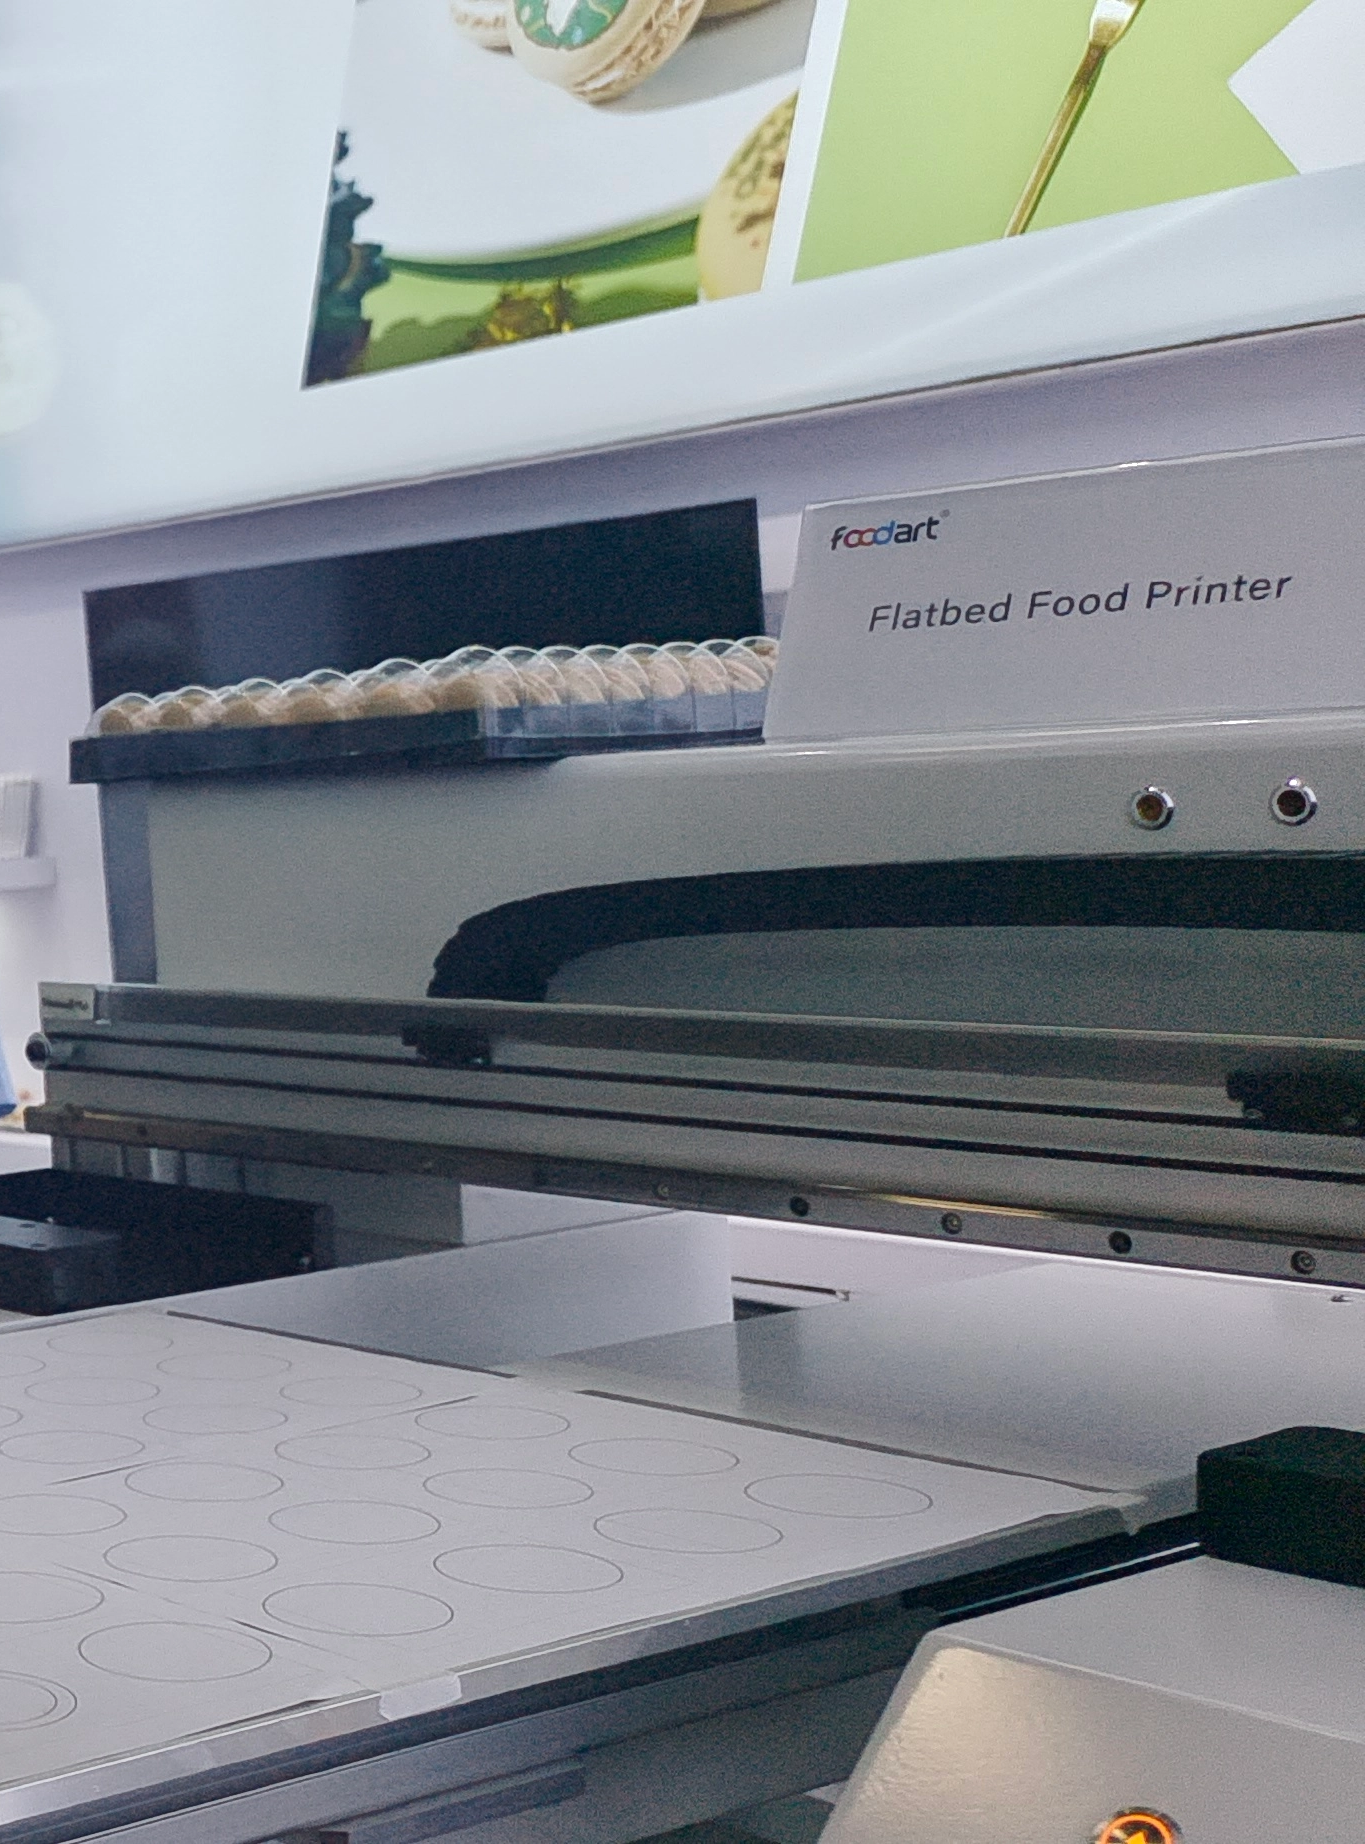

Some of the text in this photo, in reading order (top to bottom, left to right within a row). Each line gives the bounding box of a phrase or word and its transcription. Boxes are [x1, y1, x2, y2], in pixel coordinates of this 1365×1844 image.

[831, 515, 940, 551] foodart
[869, 574, 1294, 632] Flatbed Food Printer
